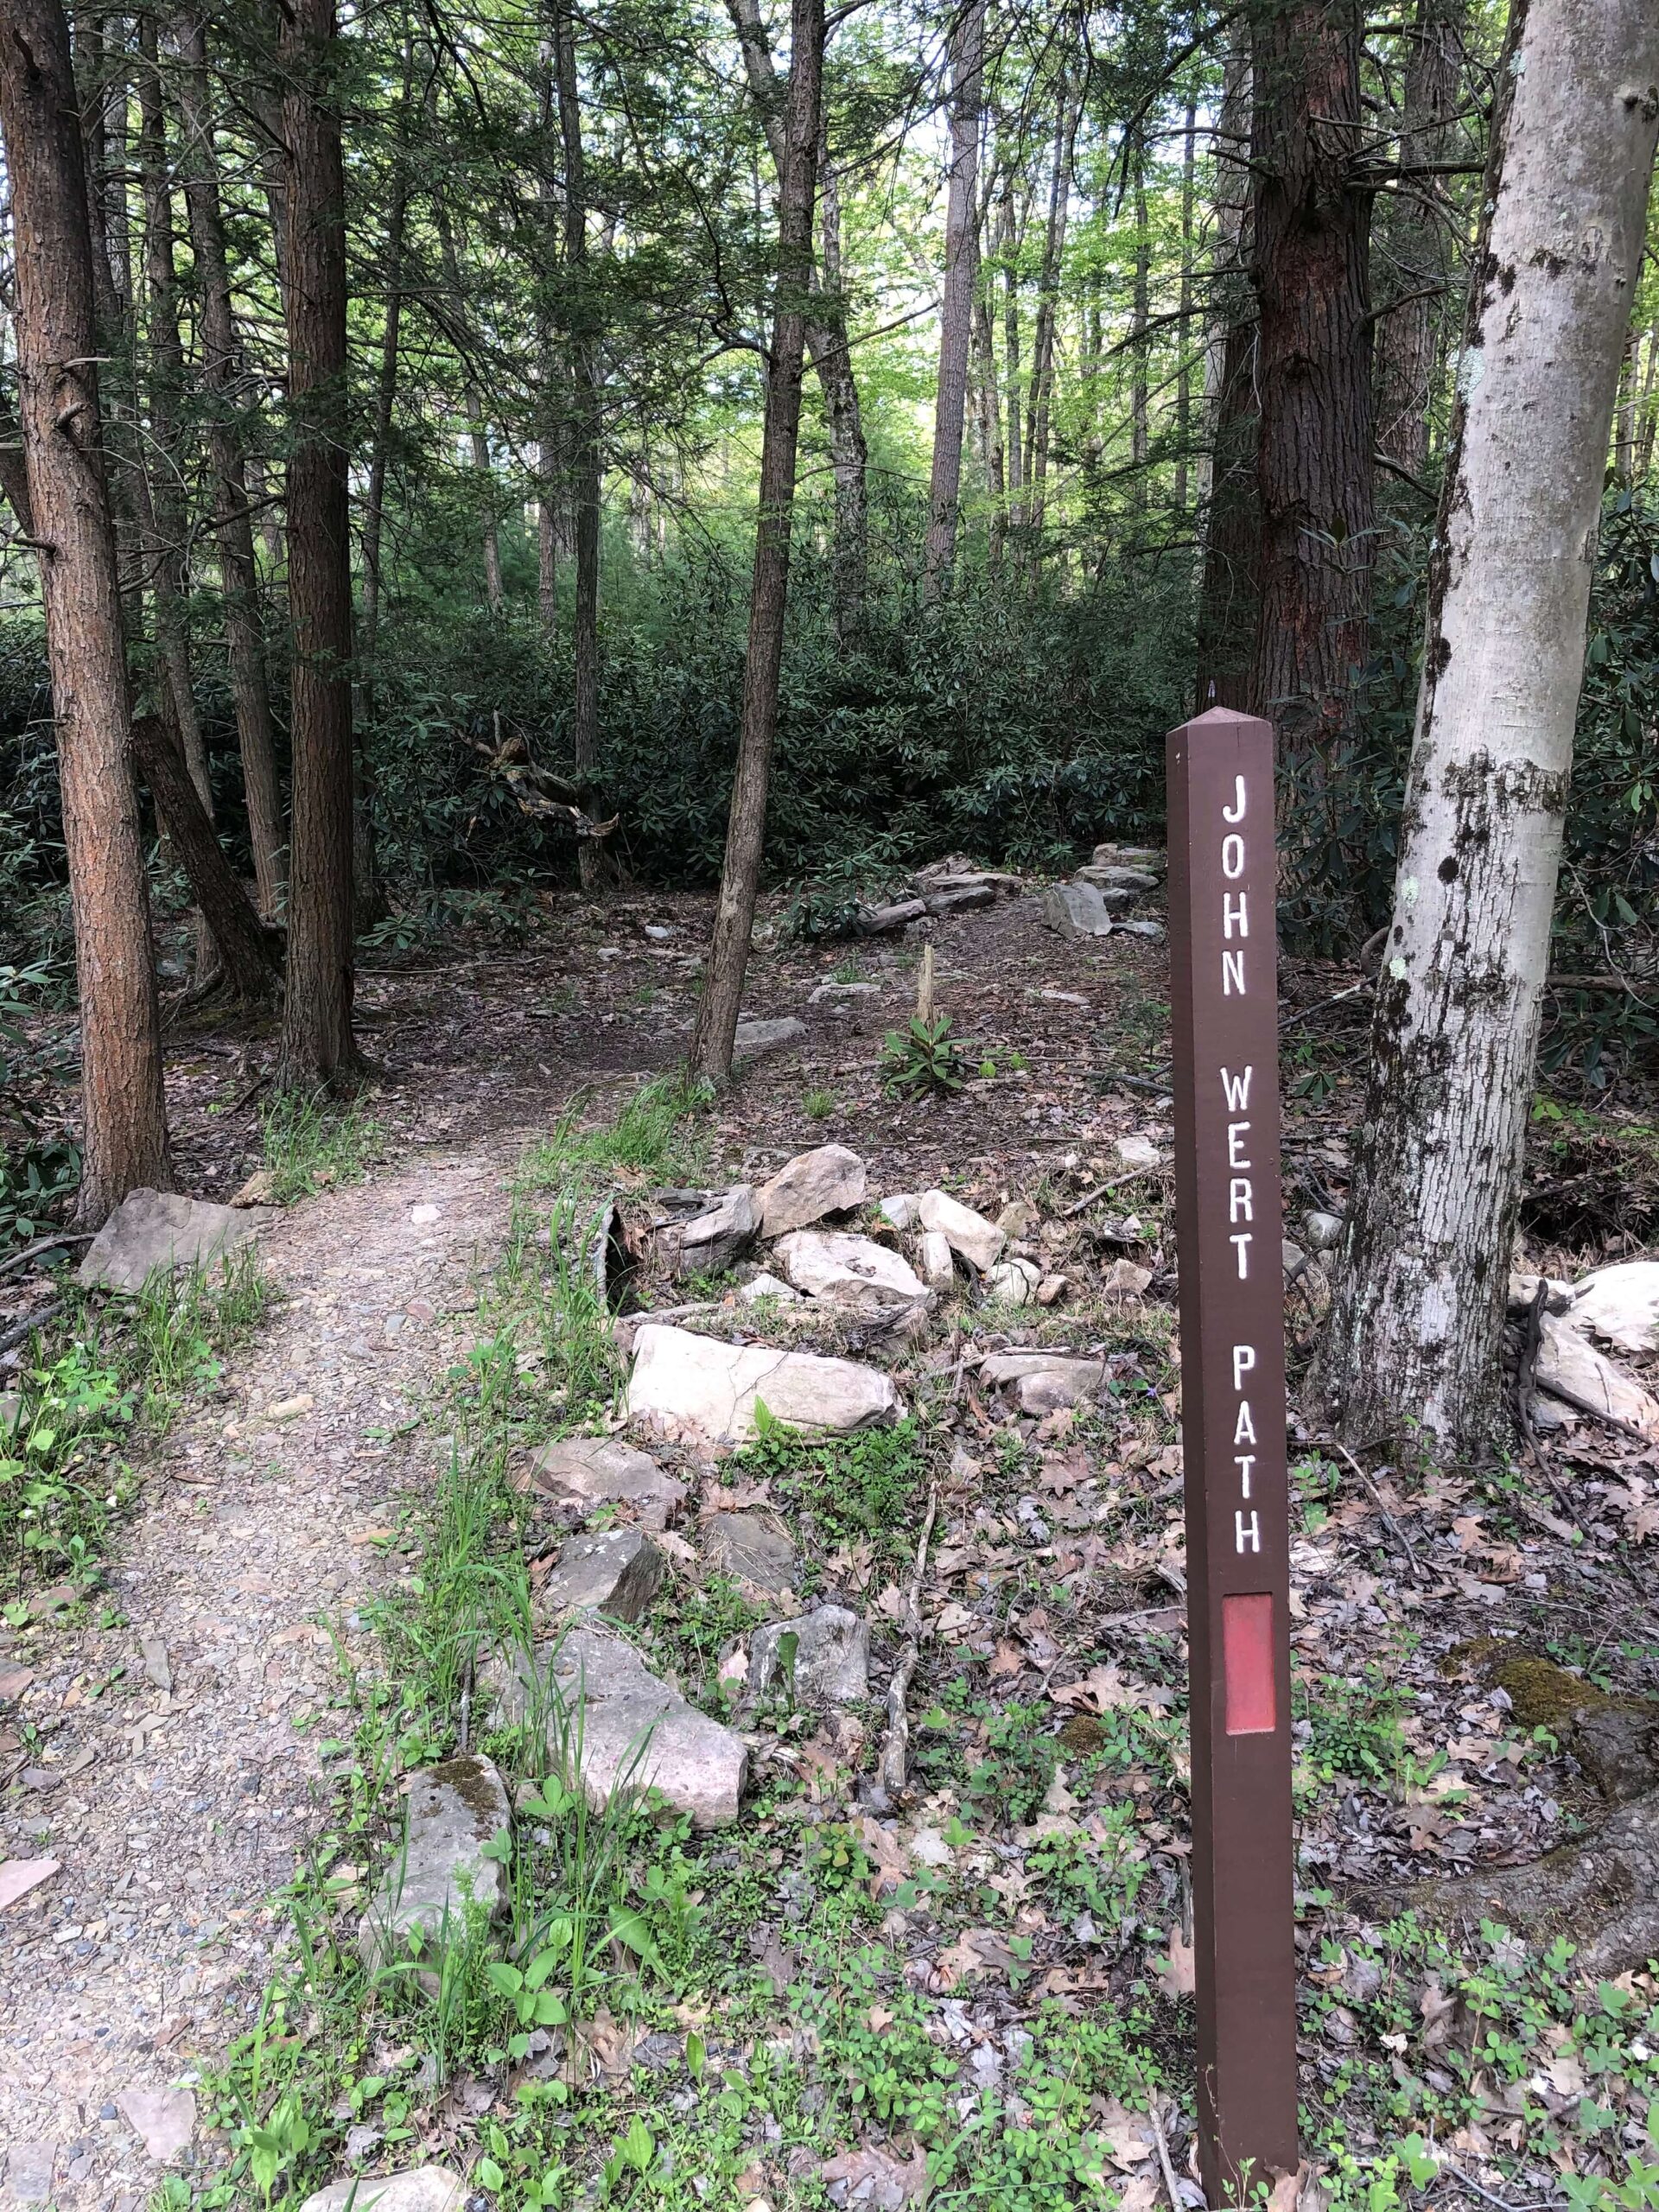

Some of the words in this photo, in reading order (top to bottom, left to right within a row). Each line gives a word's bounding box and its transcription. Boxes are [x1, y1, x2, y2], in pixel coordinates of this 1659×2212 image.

[1221, 773, 1250, 997] JOHN
[1218, 1064, 1255, 1281] WERT
[1231, 1344, 1262, 1555] PATH
